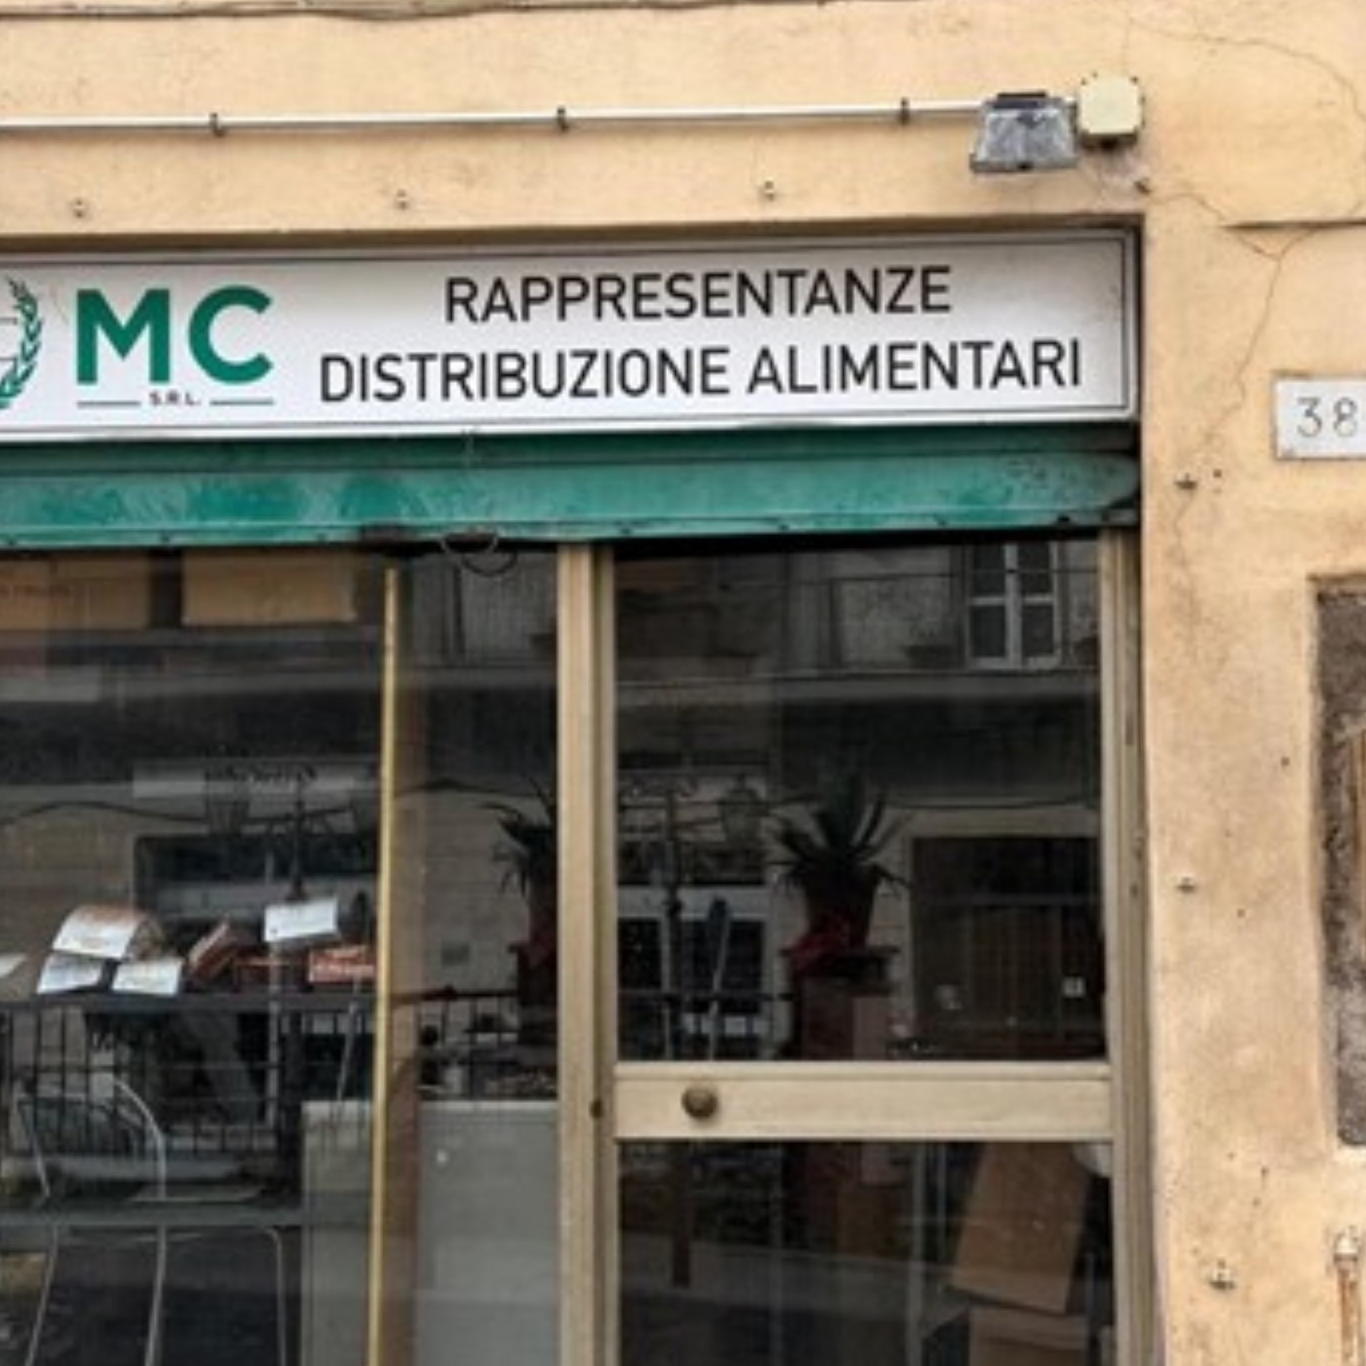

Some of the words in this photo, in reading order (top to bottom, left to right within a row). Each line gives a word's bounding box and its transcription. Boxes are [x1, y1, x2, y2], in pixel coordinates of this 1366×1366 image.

[445, 265, 953, 323] RAPPRESENTANZE
[76, 285, 275, 386] MC
[148, 390, 202, 407] S.R.L.
[319, 346, 731, 403] DISTRIBUZIONE
[746, 337, 1082, 395] ALIMENTARI
[1296, 396, 1359, 438] 38
